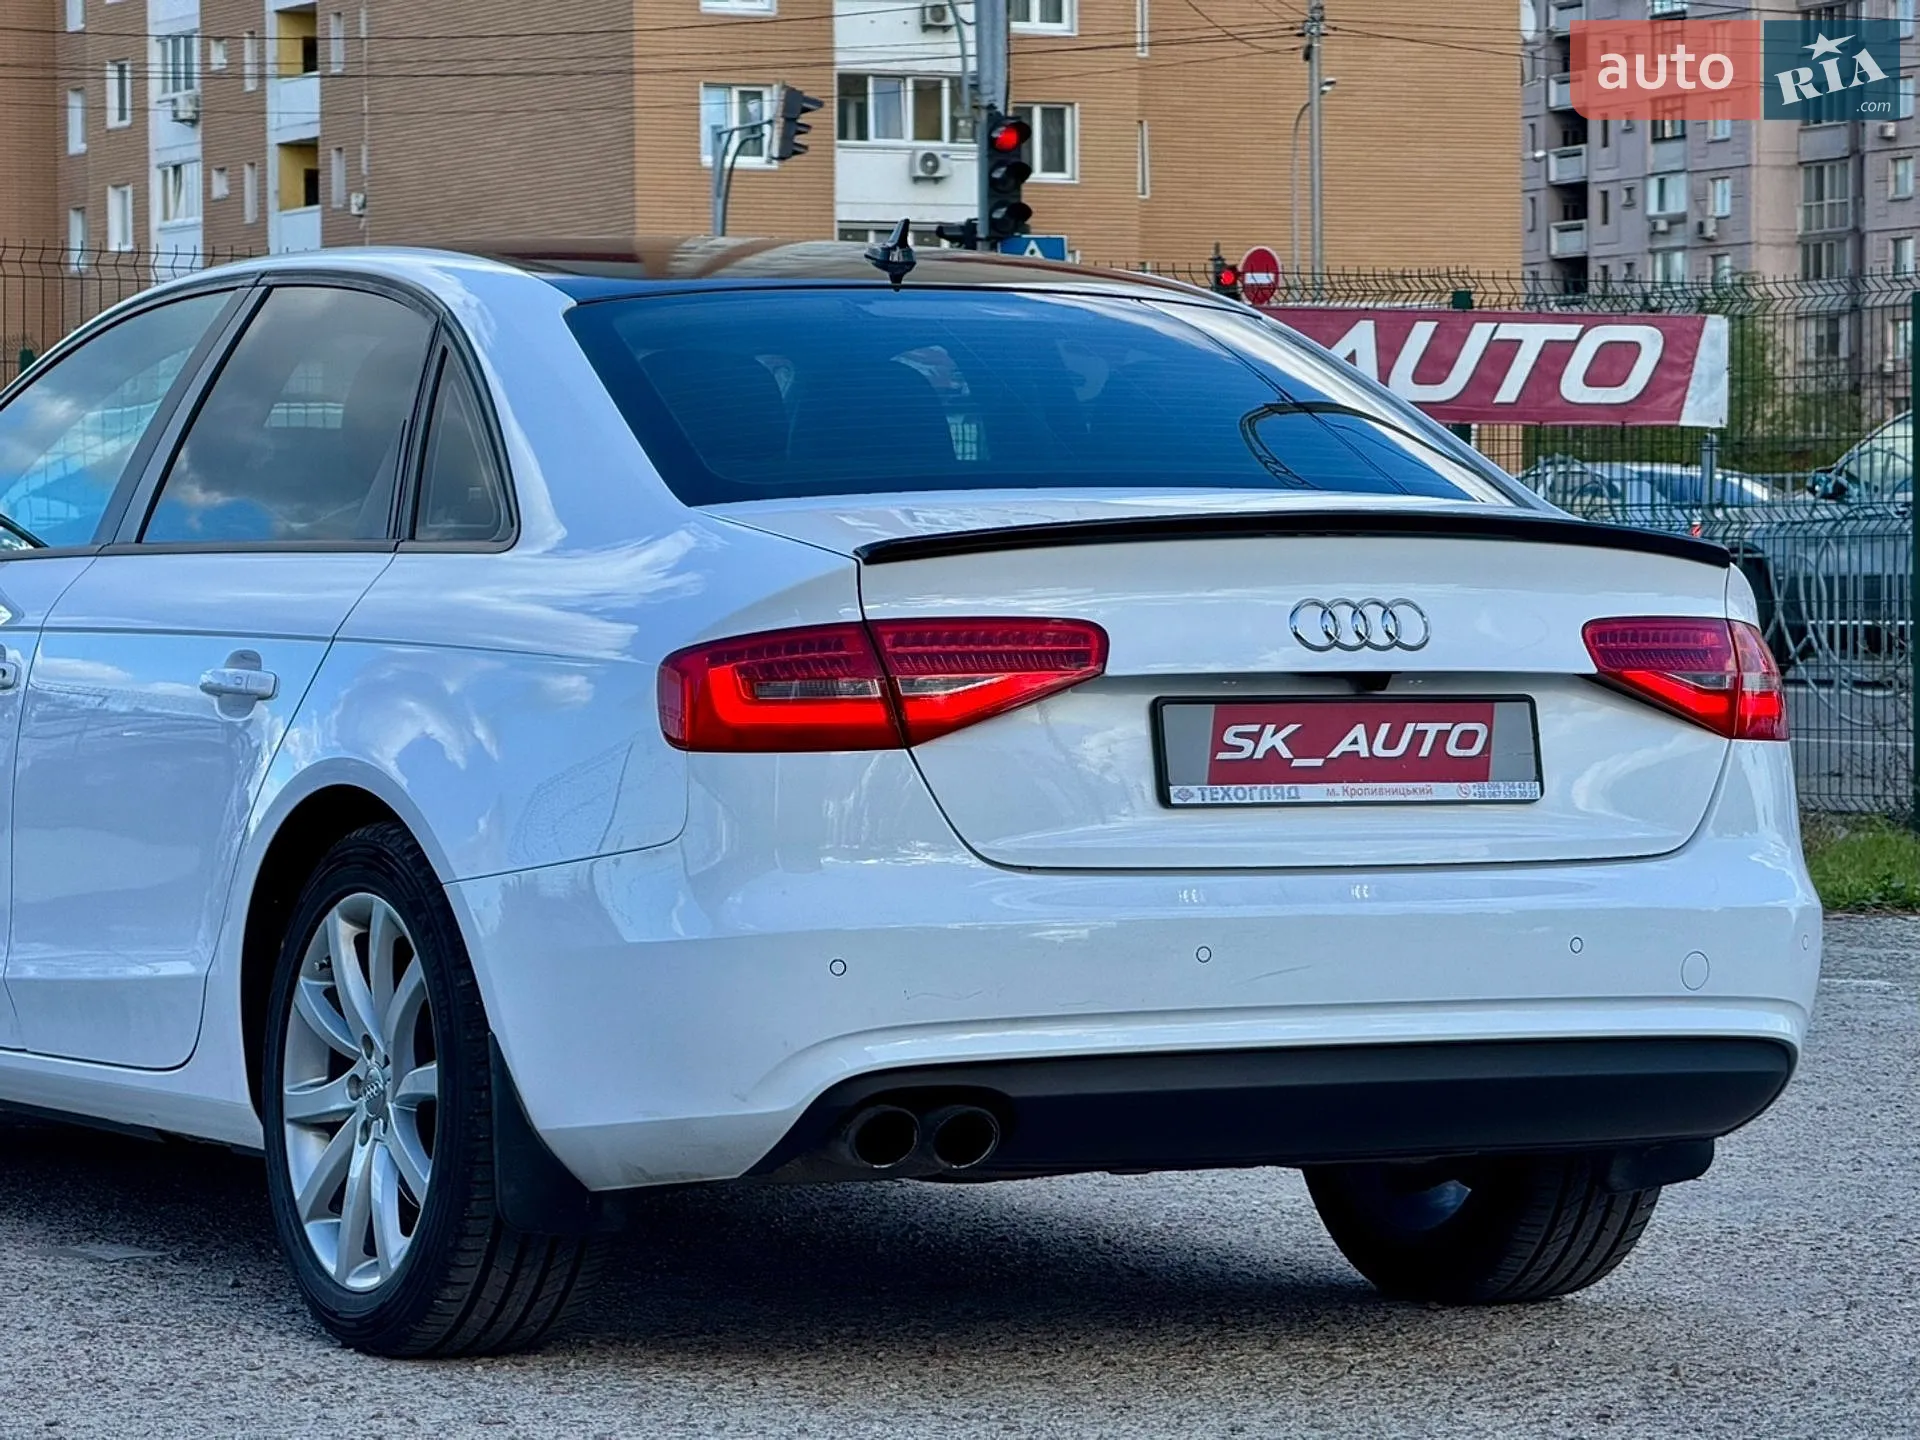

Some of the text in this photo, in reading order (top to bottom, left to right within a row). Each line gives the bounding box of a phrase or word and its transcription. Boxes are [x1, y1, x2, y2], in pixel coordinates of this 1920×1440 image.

[1215, 722, 1488, 767] SK_AUTO
[1197, 785, 1302, 802] ТЕХОГЛЯД
[1342, 784, 1433, 798] Кропивницький
